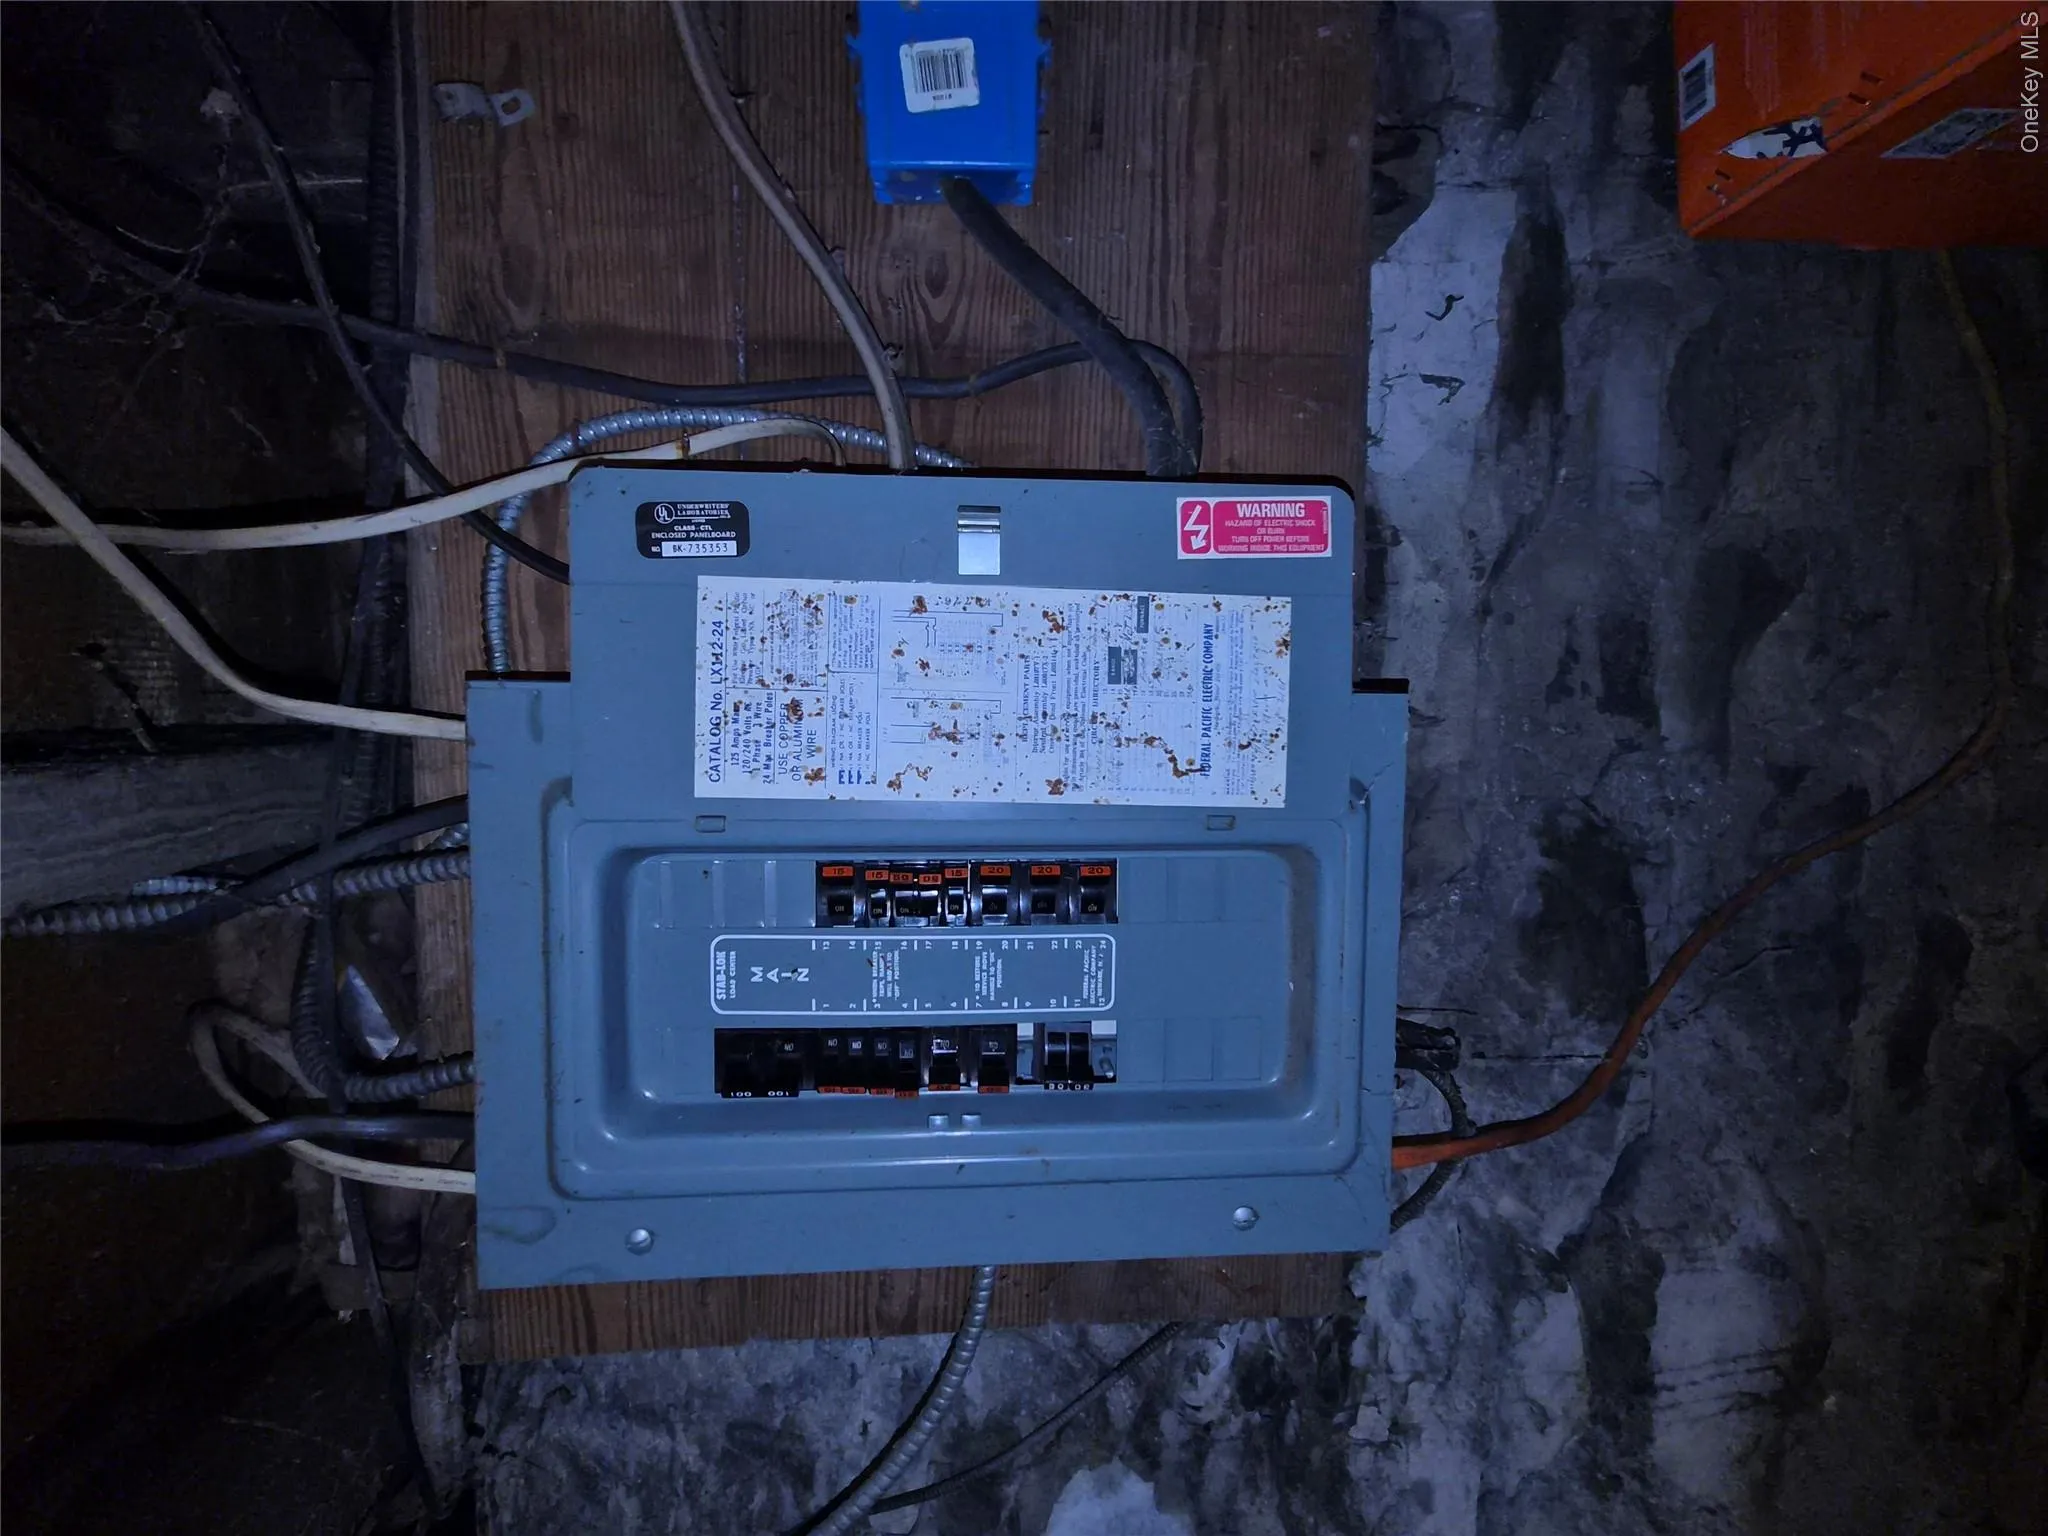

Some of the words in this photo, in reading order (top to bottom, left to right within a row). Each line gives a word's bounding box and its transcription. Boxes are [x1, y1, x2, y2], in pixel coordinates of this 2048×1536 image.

[1237, 503, 1306, 518] WARNING
[1203, 624, 1214, 664] COMPANY
[711, 620, 724, 685] LX112-24
[1202, 668, 1214, 702] ELECTRIC
[710, 690, 723, 711] No.
[765, 692, 773, 713] Poles
[753, 702, 762, 719] Wire
[743, 716, 752, 735] Volts
[779, 702, 789, 748] COPPER
[1201, 707, 1213, 738] PACIFIC
[731, 728, 742, 749] Amps
[807, 729, 817, 759] WIRE
[709, 716, 722, 783] CATALOG
[752, 740, 761, 763] Phase
[730, 752, 740, 766] 125
[742, 739, 751, 774] 120/240
[1200, 742, 1212, 777] FEDERAL
[778, 753, 788, 774] USE
[792, 765, 802, 781] OR
[763, 775, 772, 784] 24
[1038, 866, 1053, 874] 20
[900, 906, 910, 914] ON
[950, 903, 960, 911] ON
[823, 941, 830, 950] 13
[849, 941, 856, 950] 14
[875, 941, 882, 950] 15
[901, 941, 908, 950] 16
[925, 941, 932, 950] 17
[952, 941, 959, 950] 18
[976, 941, 983, 950] 19
[1002, 940, 1009, 950] 20
[1027, 942, 1034, 950] 21
[1052, 941, 1058, 950] 22
[887, 952, 893, 961] TO
[716, 951, 726, 1001] STAB-LOK
[750, 966, 810, 984] MAIN
[1050, 999, 1057, 1008] 10
[1074, 999, 1081, 1007] 11
[1099, 998, 1105, 1007] 12
[784, 1043, 794, 1051] ON
[852, 1041, 862, 1049] ON
[878, 1043, 887, 1051] ON
